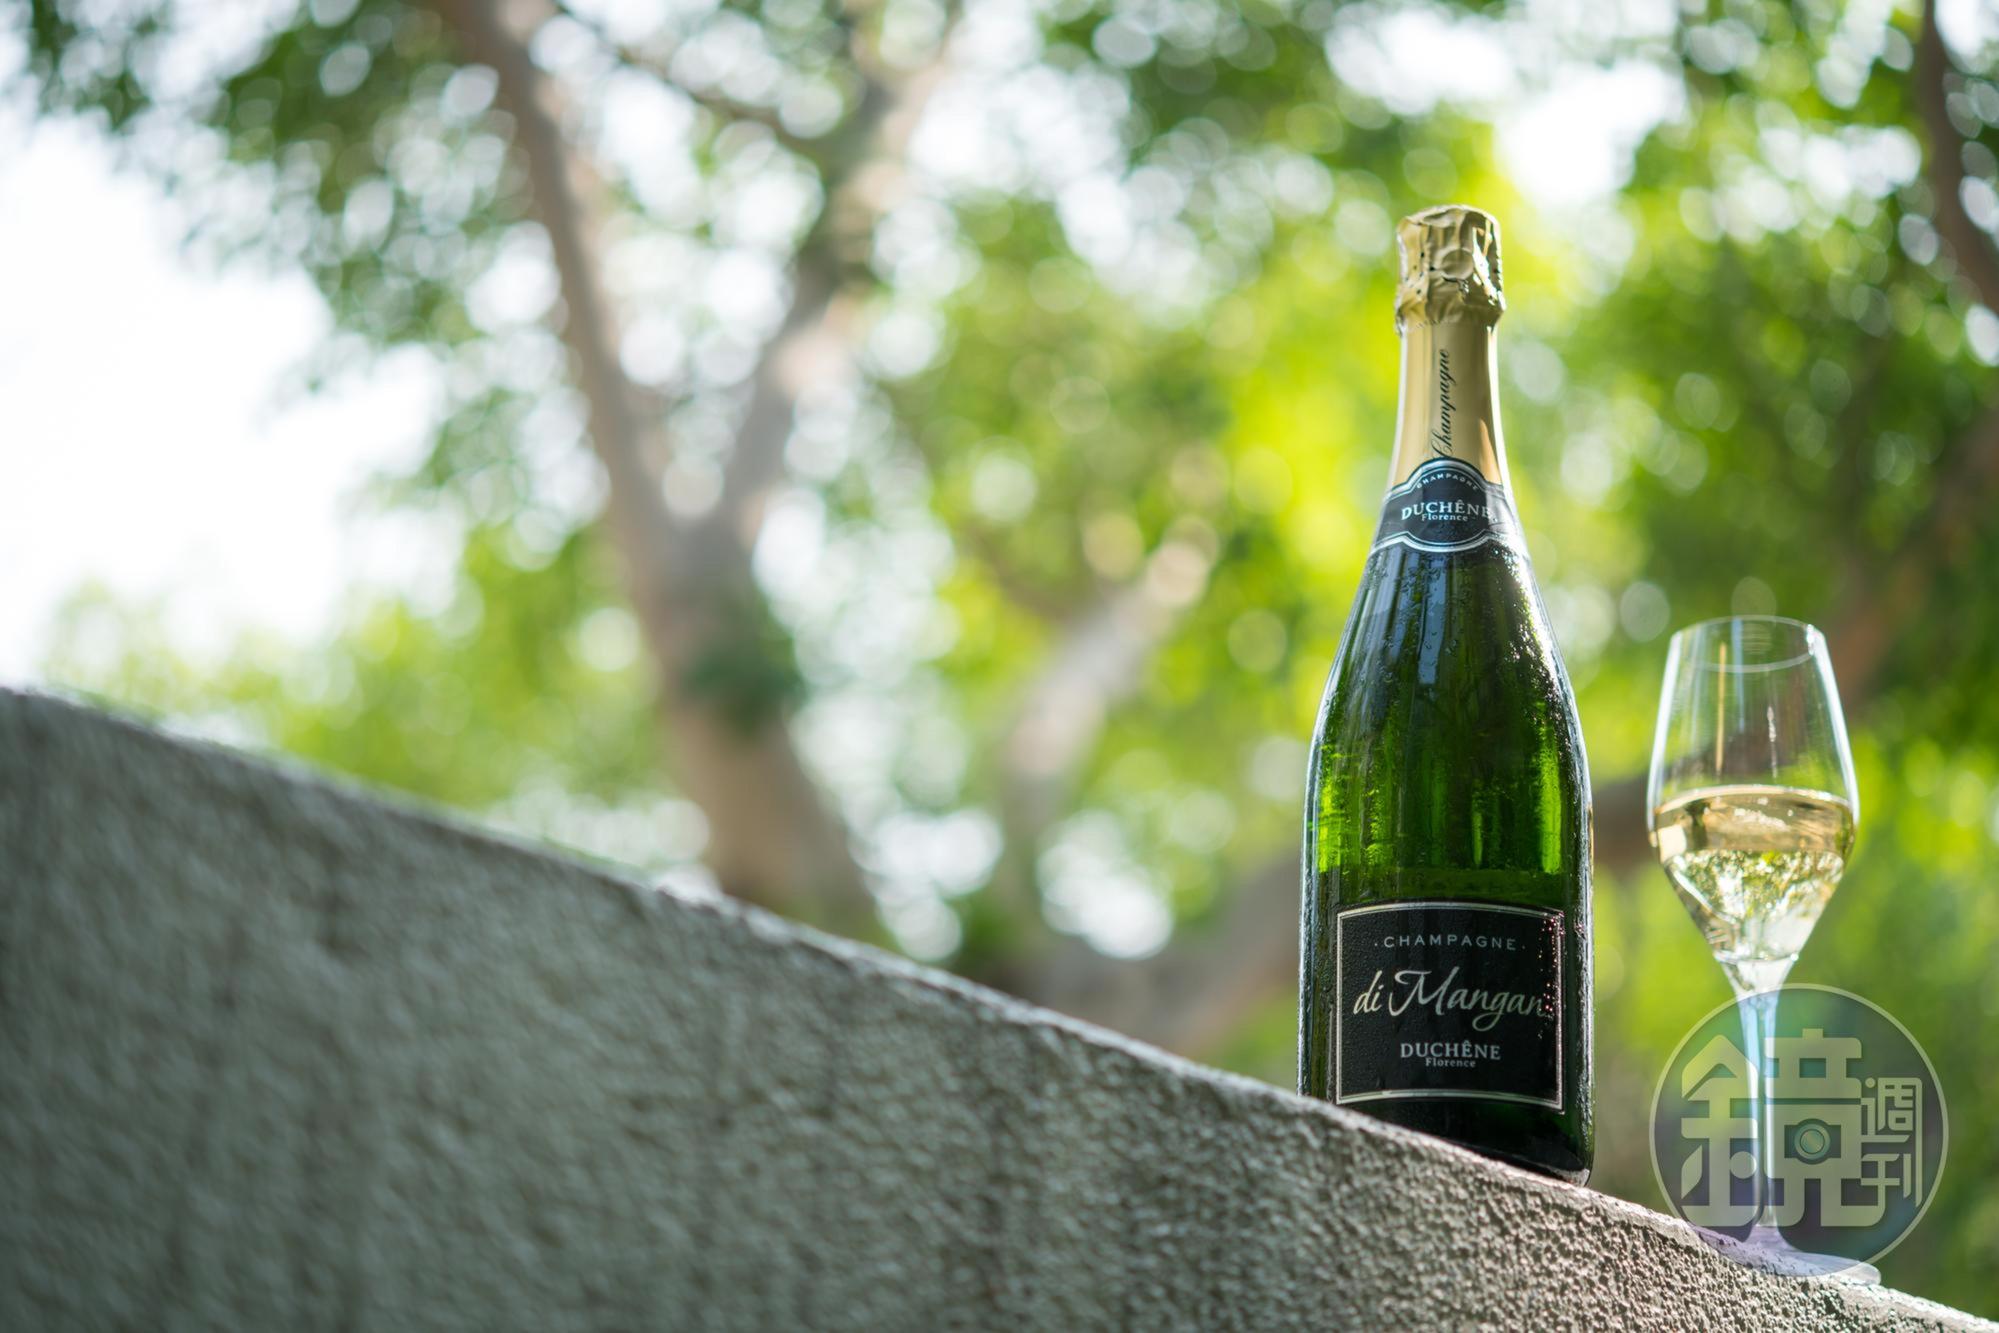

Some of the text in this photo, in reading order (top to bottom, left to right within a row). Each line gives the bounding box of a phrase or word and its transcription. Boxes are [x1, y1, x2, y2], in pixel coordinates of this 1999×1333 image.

[1431, 349, 1457, 457] Champagne
[1416, 472, 1479, 491] CHAMPAGNE
[1421, 512, 1469, 522] Florence
[1353, 970, 1384, 1014] di
[1400, 1040, 1501, 1060] DUCHÊNE
[1425, 1057, 1476, 1068] Florence
